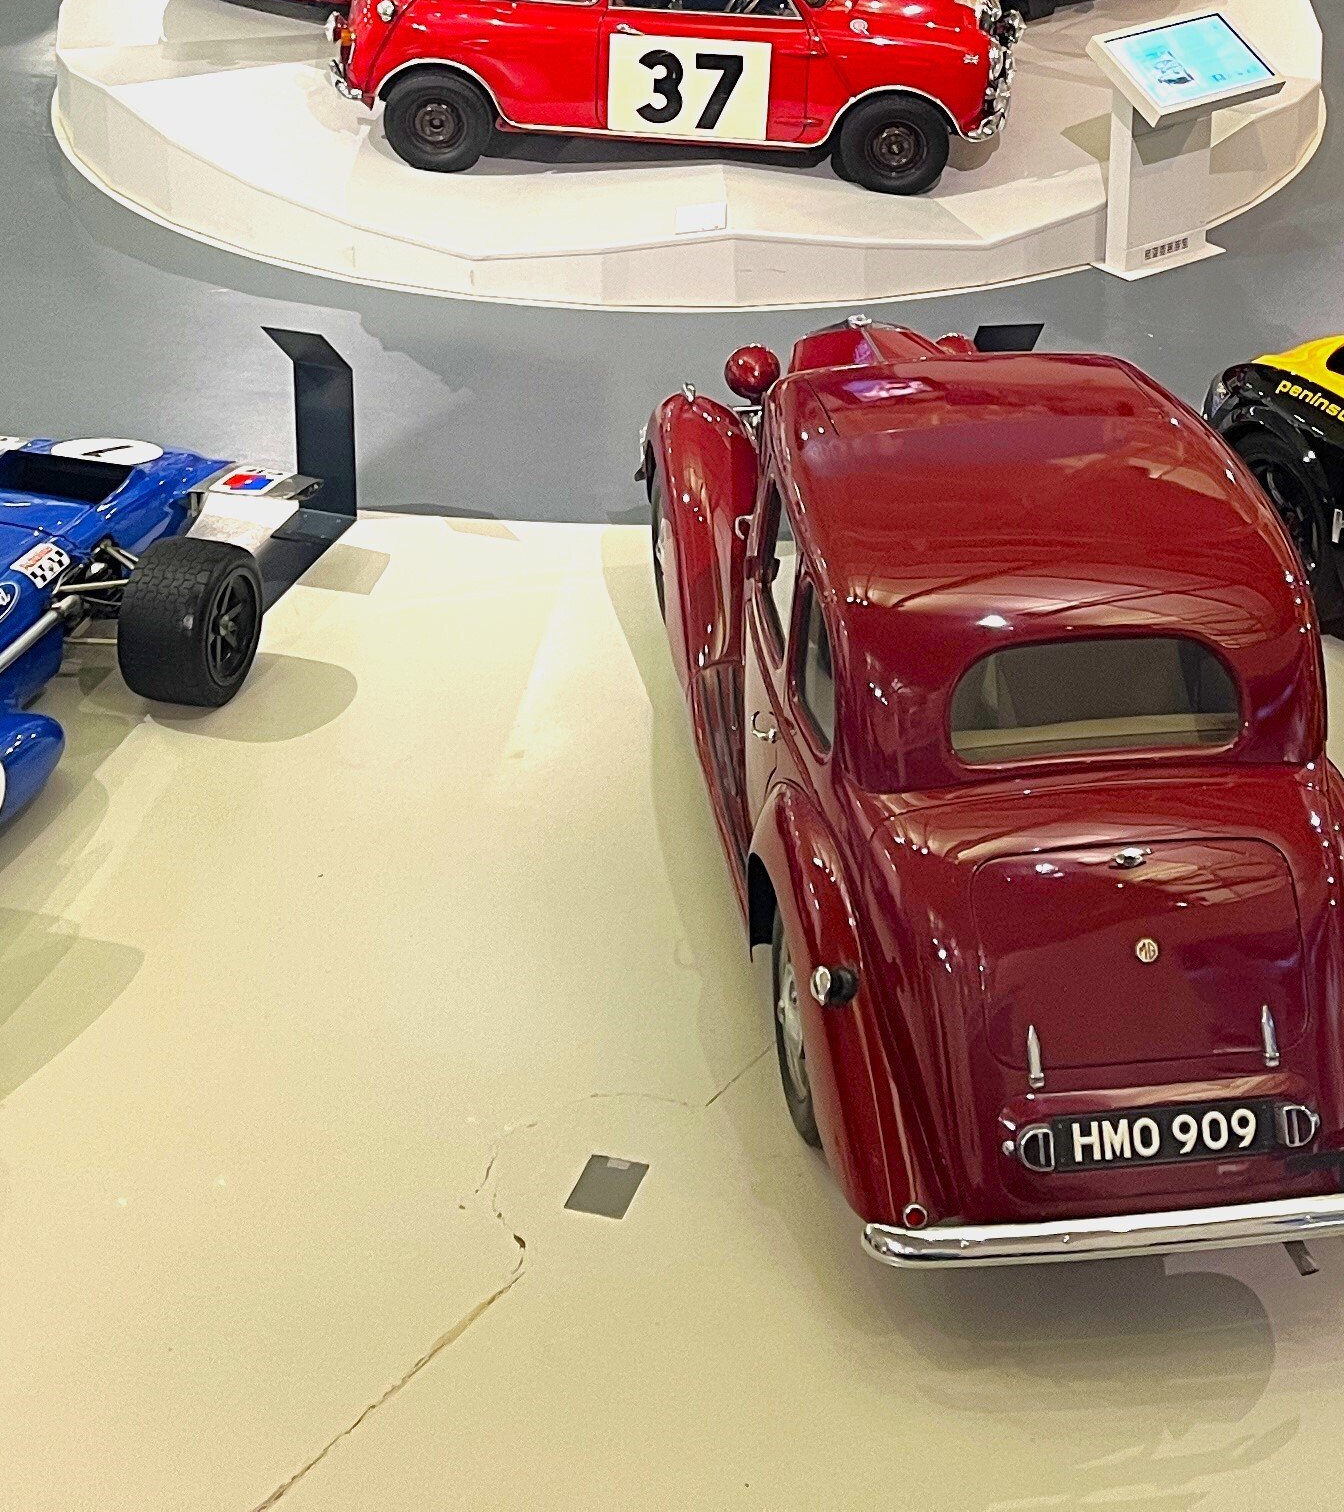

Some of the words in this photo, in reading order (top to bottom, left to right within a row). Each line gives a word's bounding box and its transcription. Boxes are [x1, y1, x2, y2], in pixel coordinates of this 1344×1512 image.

[636, 49, 744, 130] 37
[80, 445, 133, 458] 1
[1071, 1116, 1161, 1162] HMO
[1171, 1107, 1257, 1155] 909
